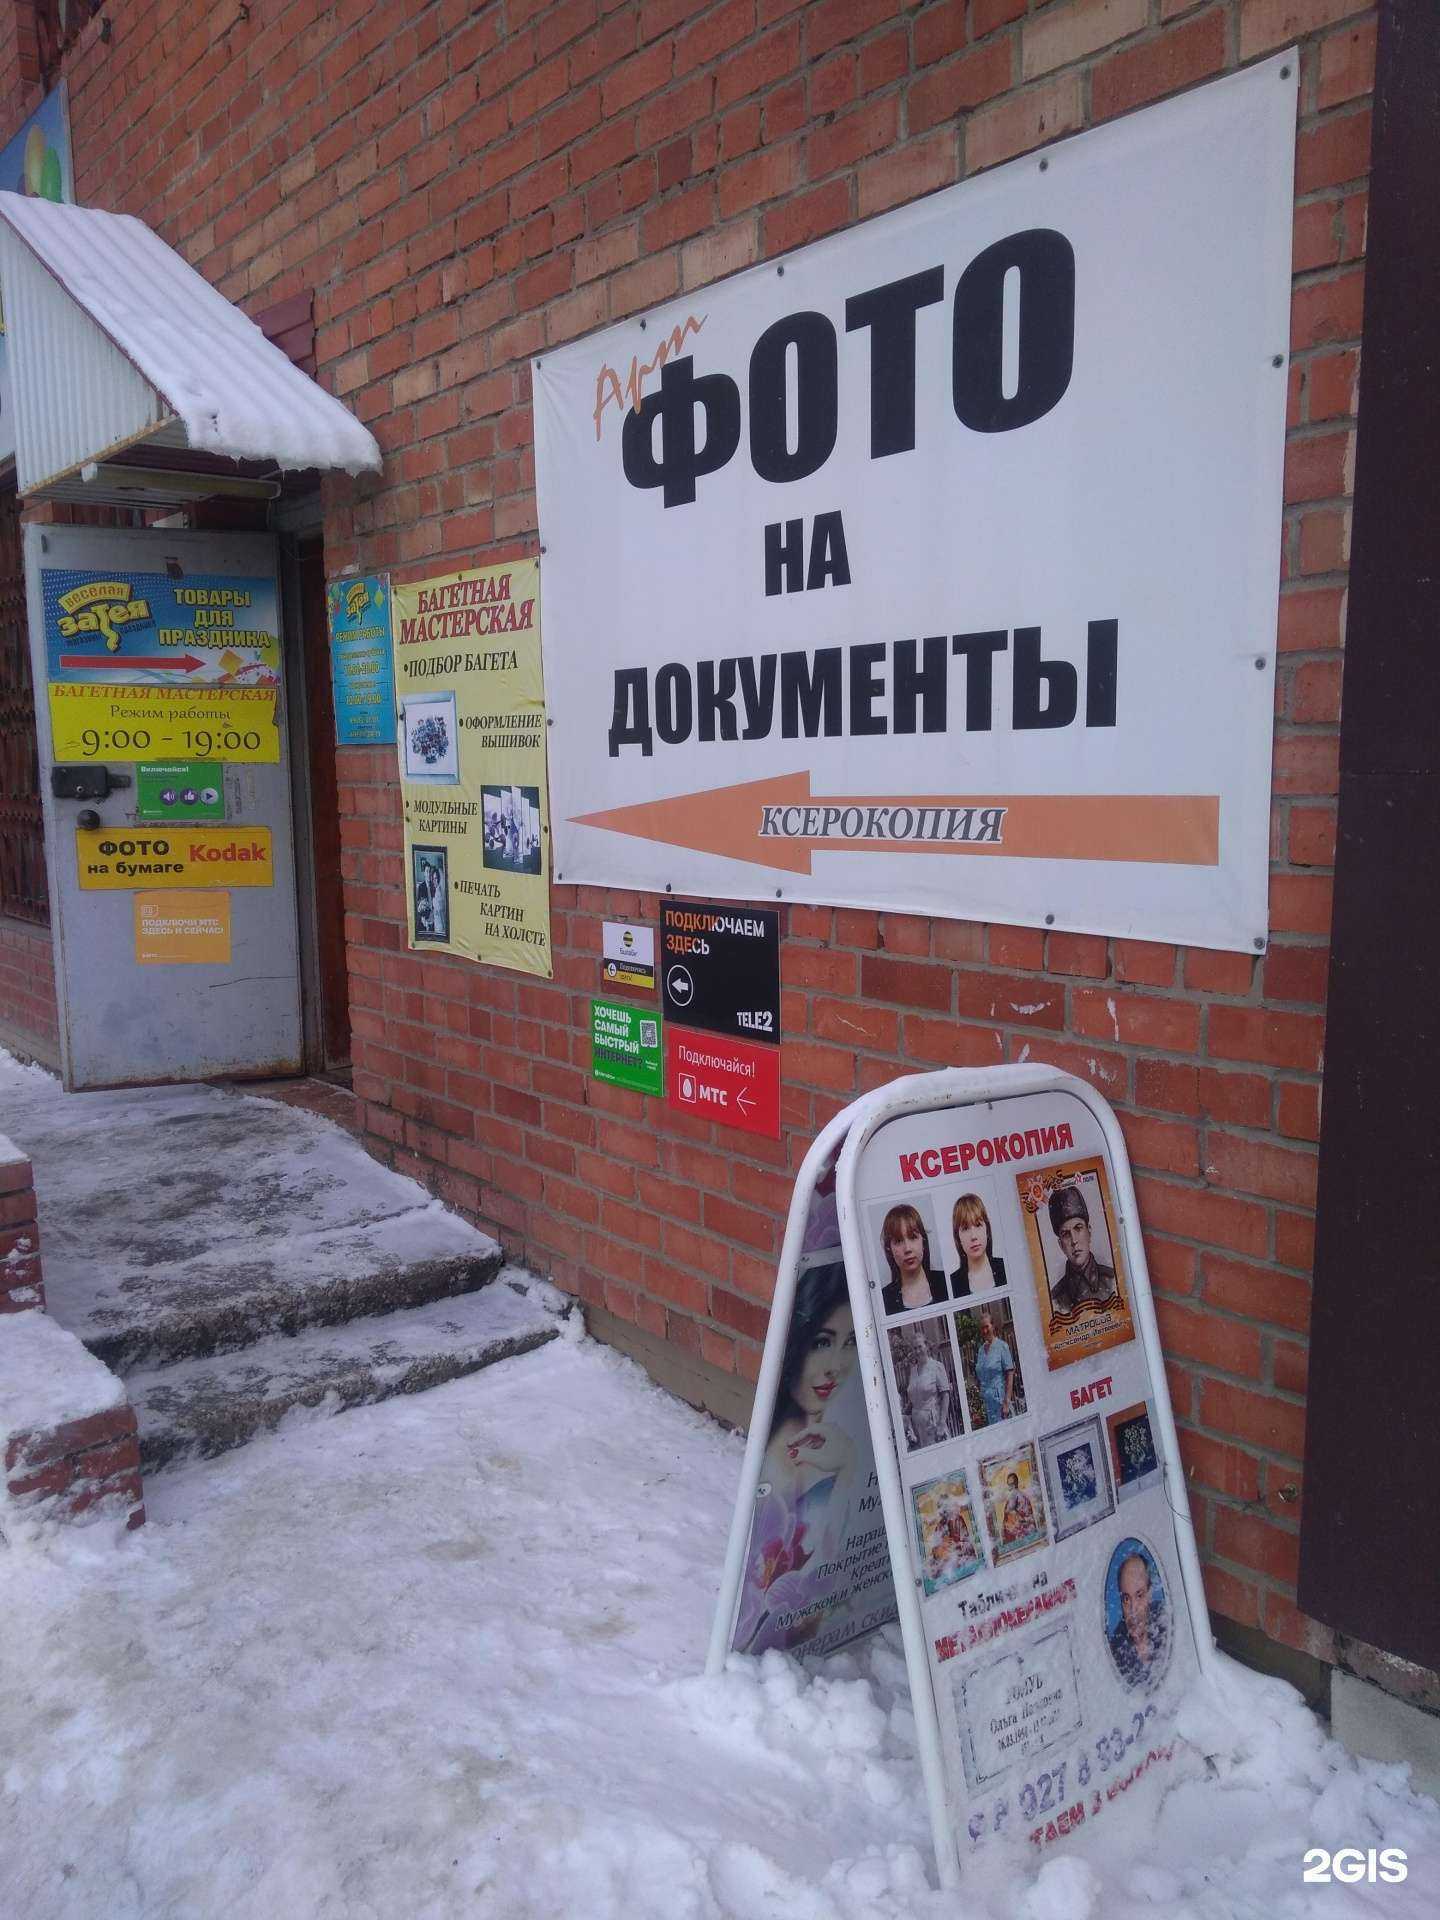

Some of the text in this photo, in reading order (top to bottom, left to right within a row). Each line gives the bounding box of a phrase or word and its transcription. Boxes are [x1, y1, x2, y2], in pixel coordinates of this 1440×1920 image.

[621, 228, 1075, 508] ФОТО
[764, 510, 851, 597] НА
[174, 588, 252, 608] ТОВАРЫ
[417, 574, 512, 614] БАГЕТНАЯ
[194, 609, 234, 628] ДЛЯ
[400, 599, 535, 645] МАСТЕРСКАЯ
[159, 629, 271, 649] ПРАЗДНИКА
[409, 654, 462, 678] ПОДБОР
[464, 650, 518, 672] БАГЕТА
[54, 684, 275, 701] БАГЕТНАЯ МАСТЕРСКАЯ
[608, 618, 1118, 757] ДОКУМЕНТЫ
[110, 705, 231, 722] Режим работы
[465, 714, 542, 729] ОФОРМЛЕНИЕ
[81, 729, 151, 756] 9:00
[182, 730, 261, 757] 19:00
[481, 734, 541, 748] ВЫШИВОК
[413, 800, 478, 816] МОДУЛЬНЫЕ
[419, 819, 468, 834] КАРТИНЫ
[759, 805, 1007, 844] КСЕРОКОПИЯ
[98, 840, 170, 856] ФОТО
[189, 843, 266, 862] Kodak
[87, 861, 184, 877] на бумаге
[460, 880, 501, 898] ПЕЧАТЬ
[480, 902, 524, 922] КАРТИН
[485, 922, 546, 946] НА ХОЛСТЕ
[665, 910, 765, 938] ПОДКЛЮЧАЕМ
[666, 934, 710, 956] ЗДЕСЬ
[594, 1005, 632, 1024] ХОЧЕШЬ
[736, 1010, 773, 1032] TELE2
[594, 1019, 629, 1037] САМЫЙ
[594, 1033, 640, 1055] БЫСТРЫЙ
[678, 1045, 755, 1078] Подключайся!
[699, 1084, 728, 1106] МТС
[899, 1122, 1074, 1183] КСЕРОКОПИЯ
[1070, 1376, 1113, 1411] БАГЕТ
[817, 1543, 883, 1579] Покрытие
[776, 1591, 841, 1632] Мужской
